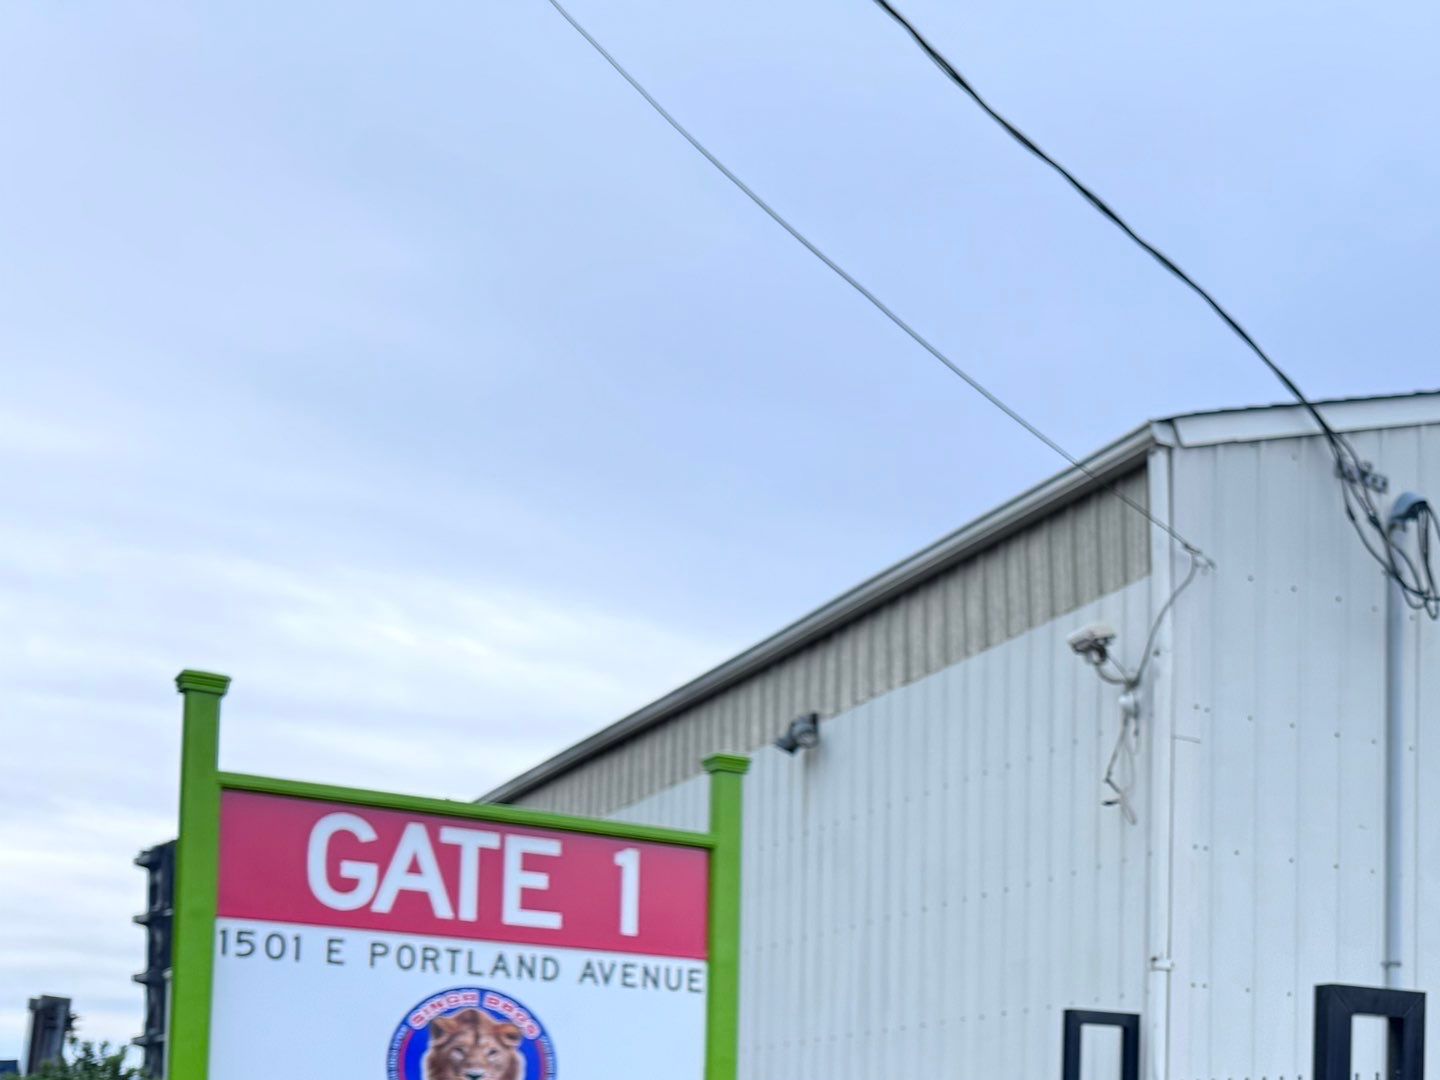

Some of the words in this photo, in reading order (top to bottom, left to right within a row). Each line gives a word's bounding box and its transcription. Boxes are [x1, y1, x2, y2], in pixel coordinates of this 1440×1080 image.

[307, 811, 564, 931] GATE
[613, 847, 641, 938] 1
[219, 928, 301, 963] 1501
[326, 937, 346, 966] E
[369, 941, 561, 983] PORTLAND
[578, 958, 704, 994] AVENUE
